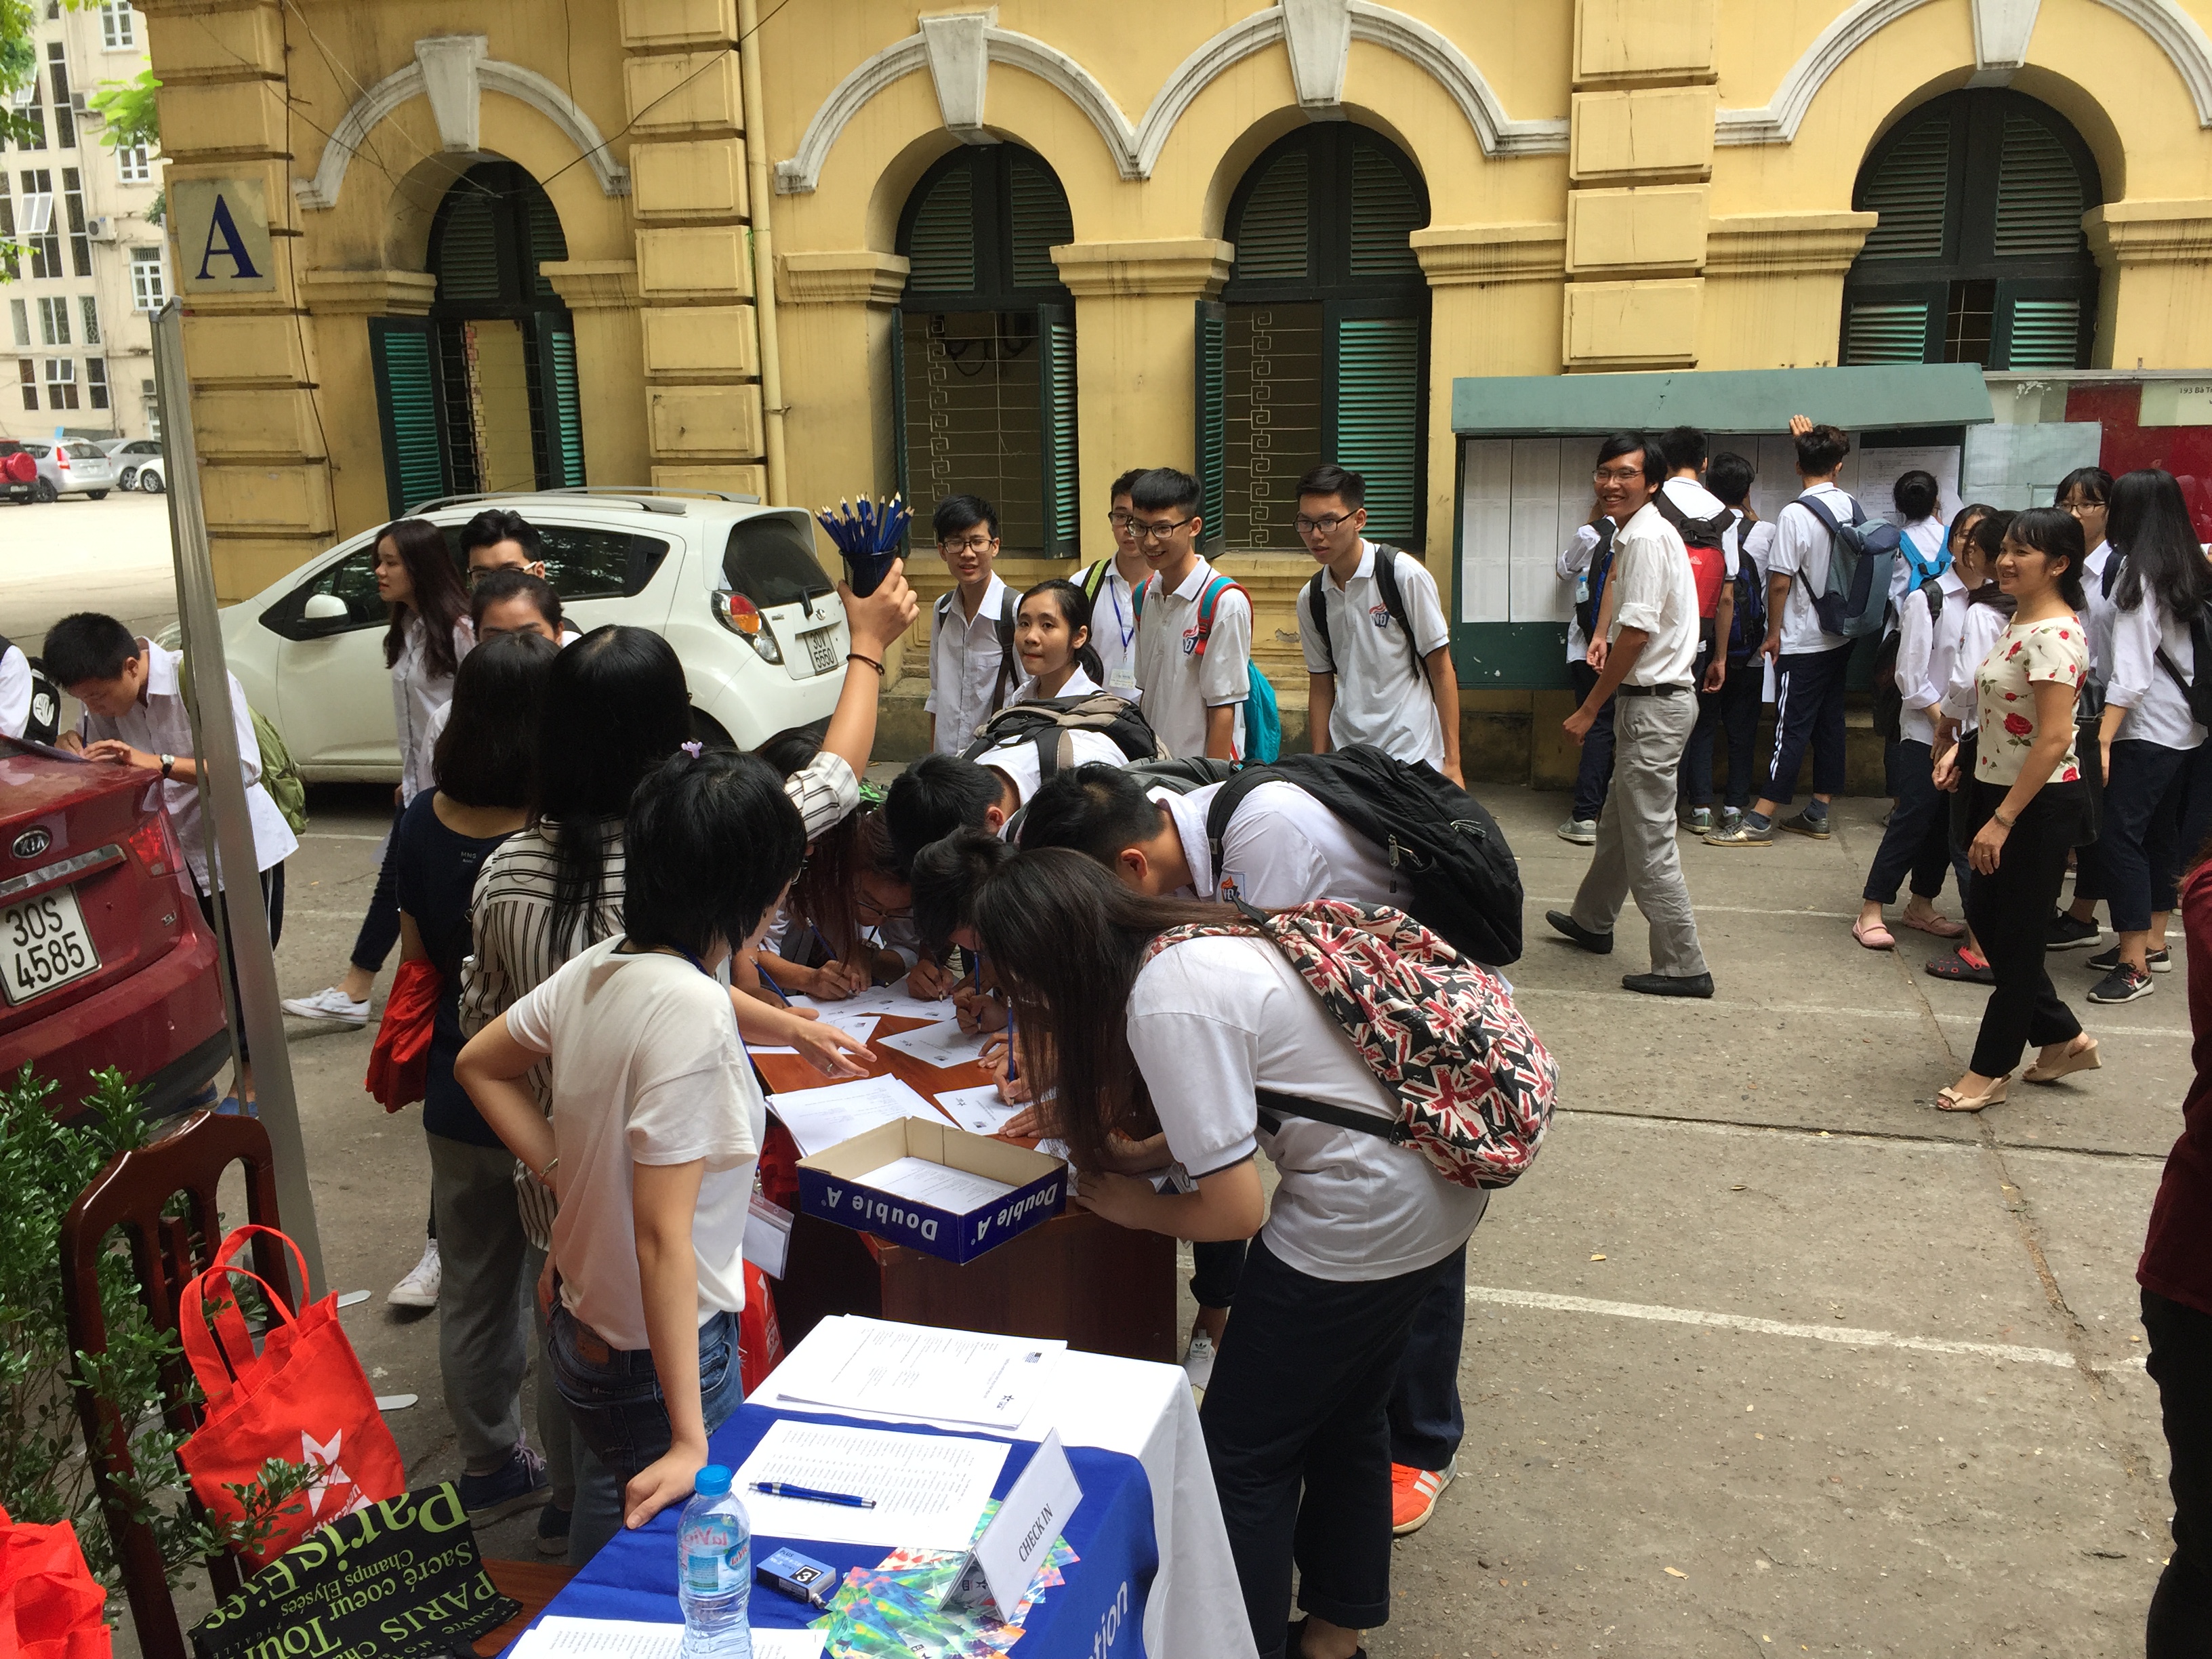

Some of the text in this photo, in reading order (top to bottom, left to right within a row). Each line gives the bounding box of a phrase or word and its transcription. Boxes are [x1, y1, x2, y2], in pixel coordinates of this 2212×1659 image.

[195, 194, 263, 279] A
[811, 630, 827, 649] 30V
[814, 647, 835, 668] 5550
[5, 895, 63, 947] 30S
[15, 930, 85, 989] 4585
[827, 1187, 939, 1242] Double A
[978, 1216, 992, 1241] A
[997, 1183, 1058, 1227] Double
[285, 1481, 470, 1572] Paris
[779, 1549, 794, 1557] PLUS
[1019, 1503, 1053, 1562] CHECK IN
[281, 1549, 414, 1617] Champs Elysées
[328, 1540, 473, 1621] Sacré coeur
[796, 1572, 813, 1582] 3
[380, 1570, 498, 1643] PARIS
[1089, 1581, 1128, 1659] tion
